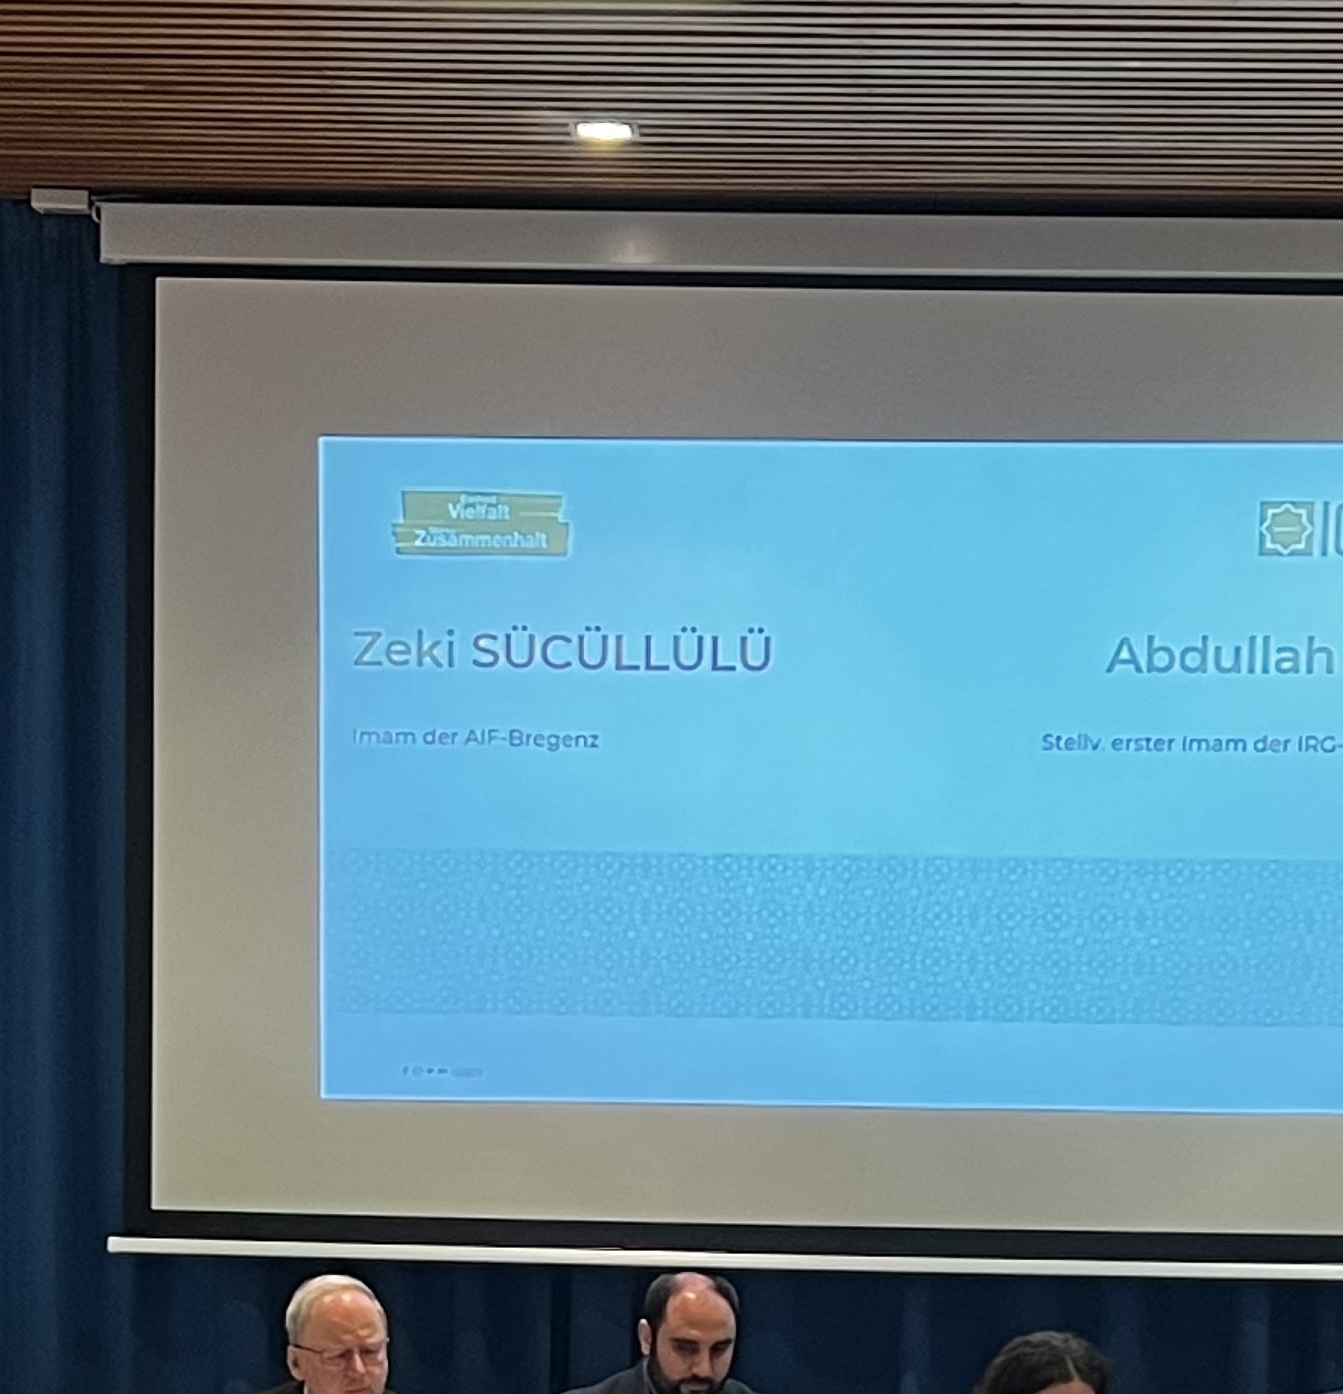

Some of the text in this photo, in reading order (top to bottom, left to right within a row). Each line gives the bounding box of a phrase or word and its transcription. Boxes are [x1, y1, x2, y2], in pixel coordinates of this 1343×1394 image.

[447, 502, 511, 521] Vielfalt
[413, 528, 548, 550] Zusammenhalt
[353, 625, 772, 672] Zeki SÜCÜLLÜLÜ
[1105, 634, 1335, 674] Abdullah
[352, 727, 600, 752] Imam der AIF-Bregenz
[1041, 733, 1106, 752] Stellv.
[1111, 735, 1176, 752] erster
[1182, 735, 1248, 753] Imam
[1253, 735, 1291, 753] der
